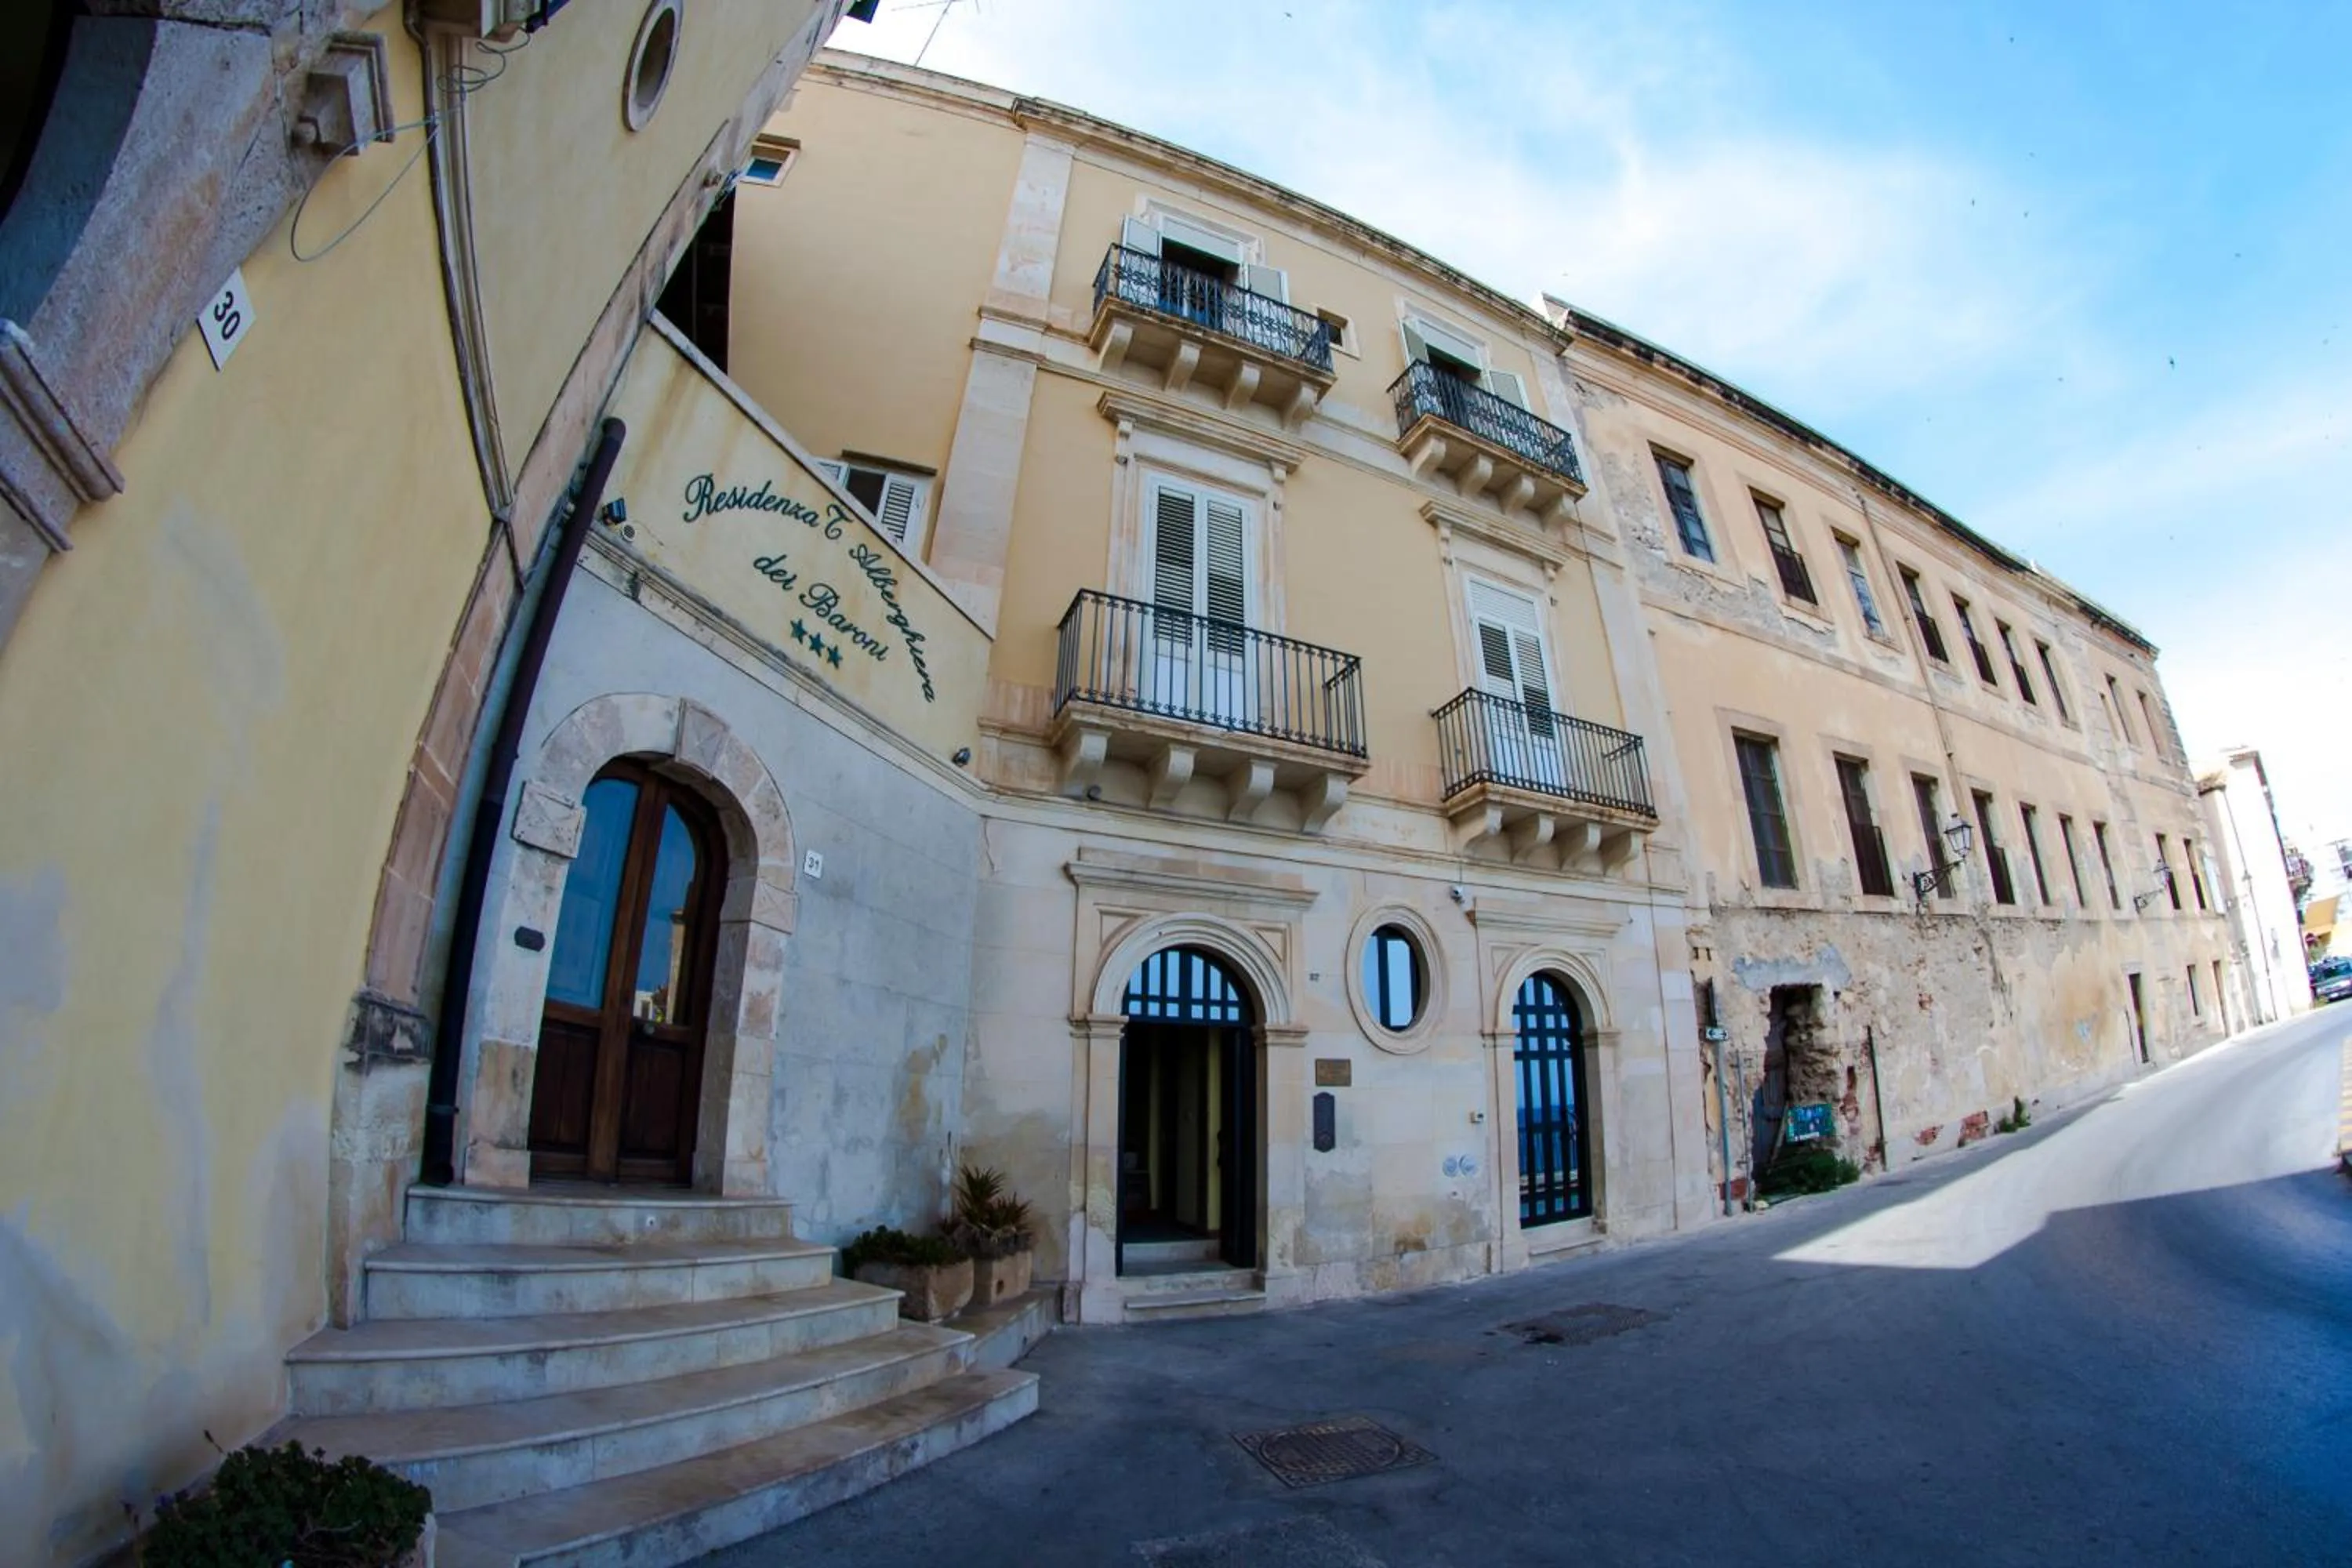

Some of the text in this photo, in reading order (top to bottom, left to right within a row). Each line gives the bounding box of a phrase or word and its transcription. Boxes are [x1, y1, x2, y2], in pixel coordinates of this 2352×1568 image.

[213, 290, 241, 341] 30
[683, 473, 819, 528] Residenza
[848, 543, 935, 703] Alberghiera
[753, 554, 889, 662] dei Baroni
